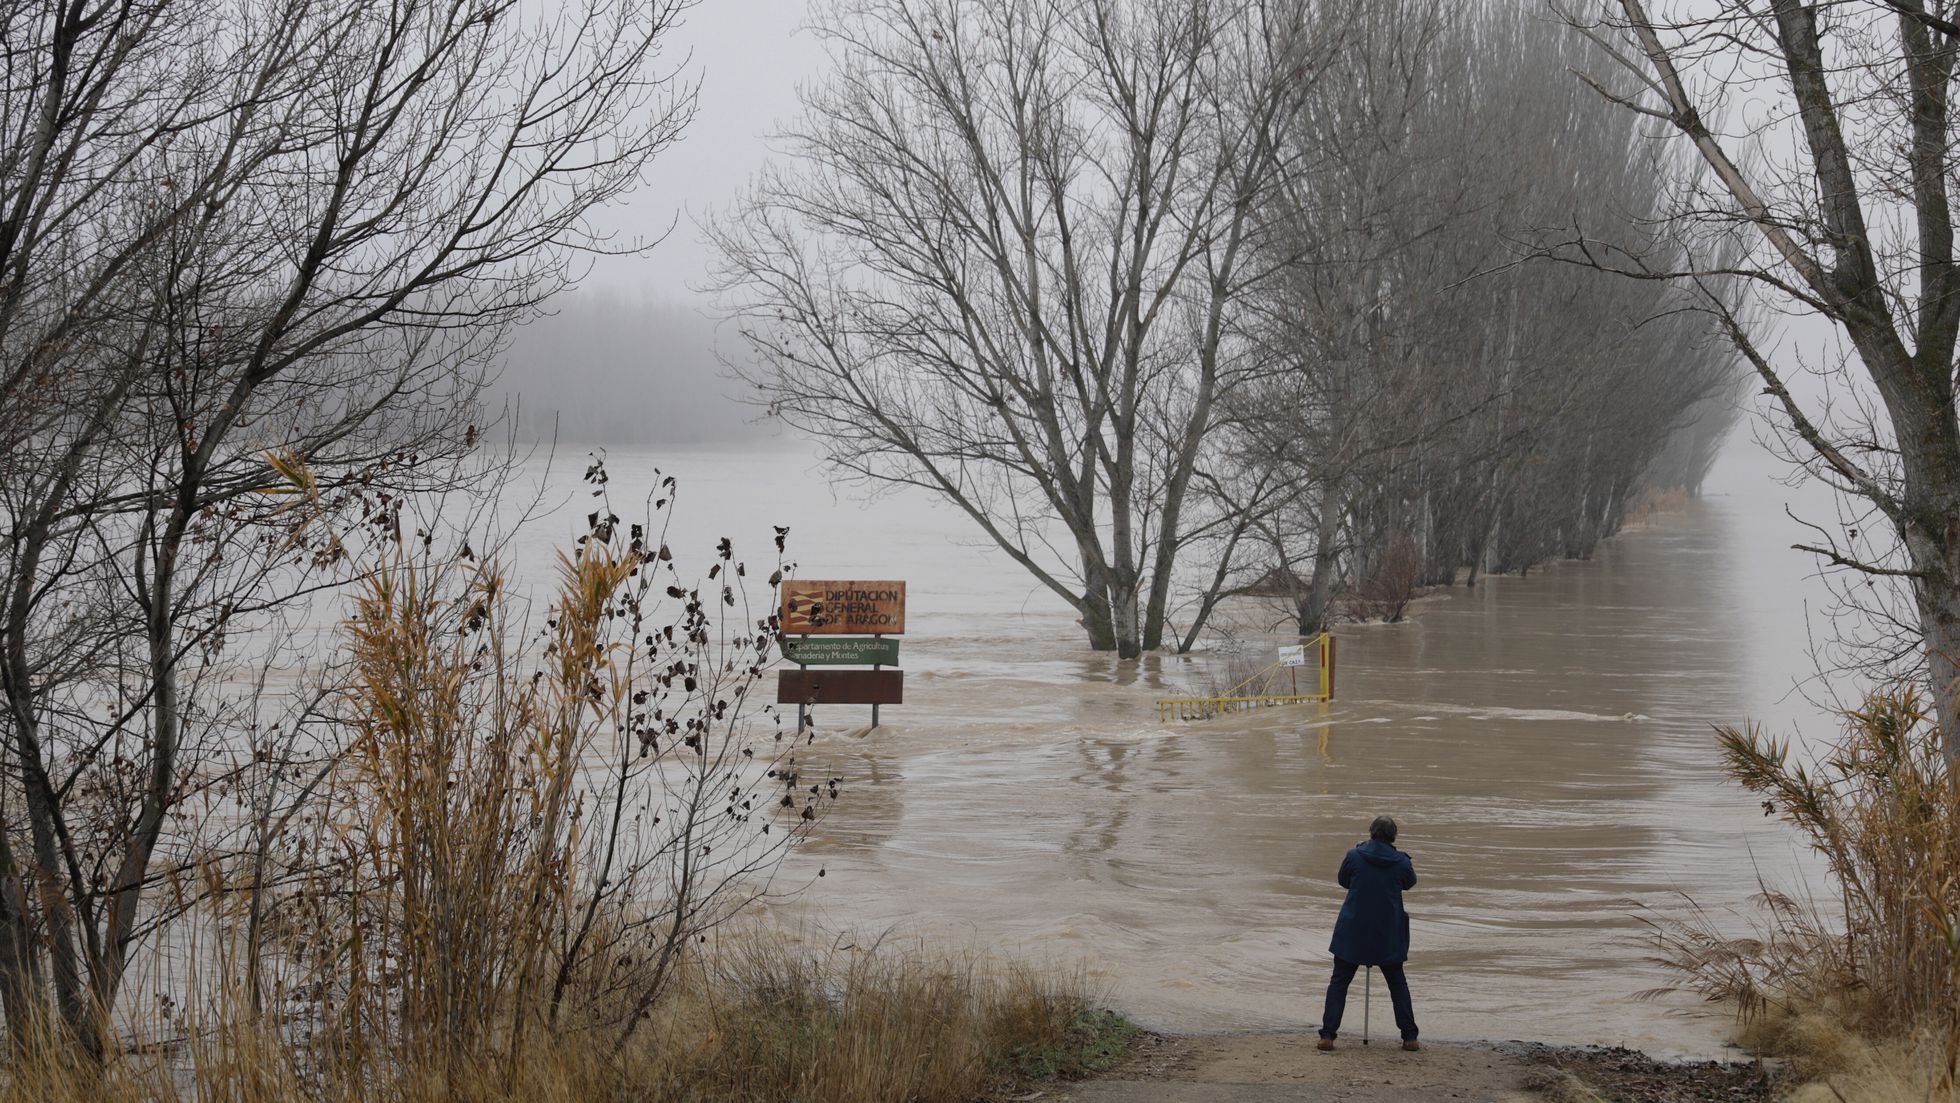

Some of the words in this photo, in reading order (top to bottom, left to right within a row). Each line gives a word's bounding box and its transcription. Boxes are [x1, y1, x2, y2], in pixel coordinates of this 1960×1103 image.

[825, 590, 898, 602] DIPUTACION
[825, 602, 879, 613] GENERAL
[842, 642, 852, 650] de
[825, 652, 831, 662] y
[831, 651, 859, 659] Montes
